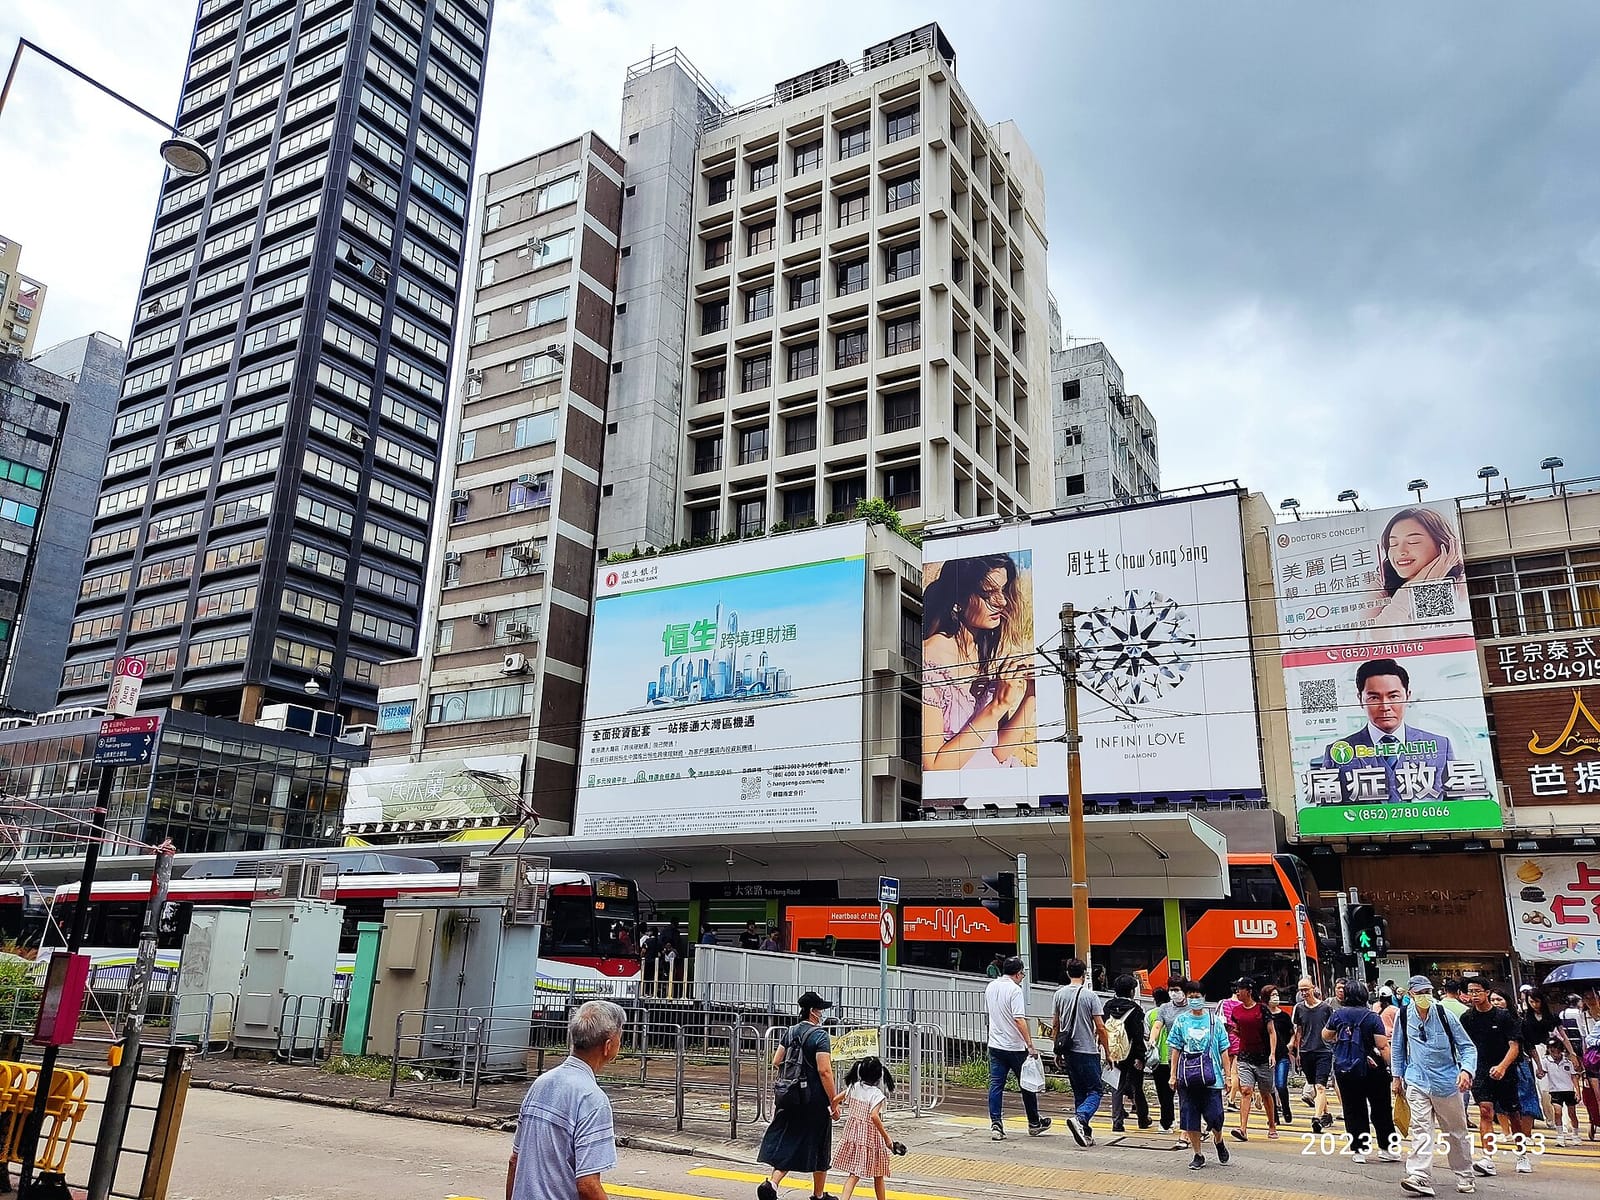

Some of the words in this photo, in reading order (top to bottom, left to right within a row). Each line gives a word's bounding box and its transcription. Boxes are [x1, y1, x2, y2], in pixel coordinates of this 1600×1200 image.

[1291, 532, 1327, 543] DOCTOR'S
[1329, 526, 1366, 538] CONCEPT
[1067, 549, 1111, 577] 周生生
[1116, 553, 1145, 570] Chow
[1148, 549, 1177, 567] Sang
[1180, 544, 1208, 563] Sang
[1282, 549, 1374, 583] 美麗自主
[662, 619, 717, 657] 恒生
[720, 624, 797, 649] 跨境理財通
[1342, 647, 1370, 660] (852)
[1373, 644, 1399, 656] 2780
[1402, 642, 1424, 652] 1616
[1497, 638, 1600, 664] 正宗泰式
[592, 725, 651, 742] 全面投資配套
[1096, 735, 1142, 748] INFINI
[1148, 732, 1186, 746] LOVE
[1355, 740, 1437, 758] BeHEALTH
[1301, 760, 1493, 804] 痛症救星
[1358, 808, 1388, 821] (852)
[1392, 806, 1418, 818] 2780
[1422, 806, 1450, 818] 6066
[1234, 920, 1278, 938] LWB
